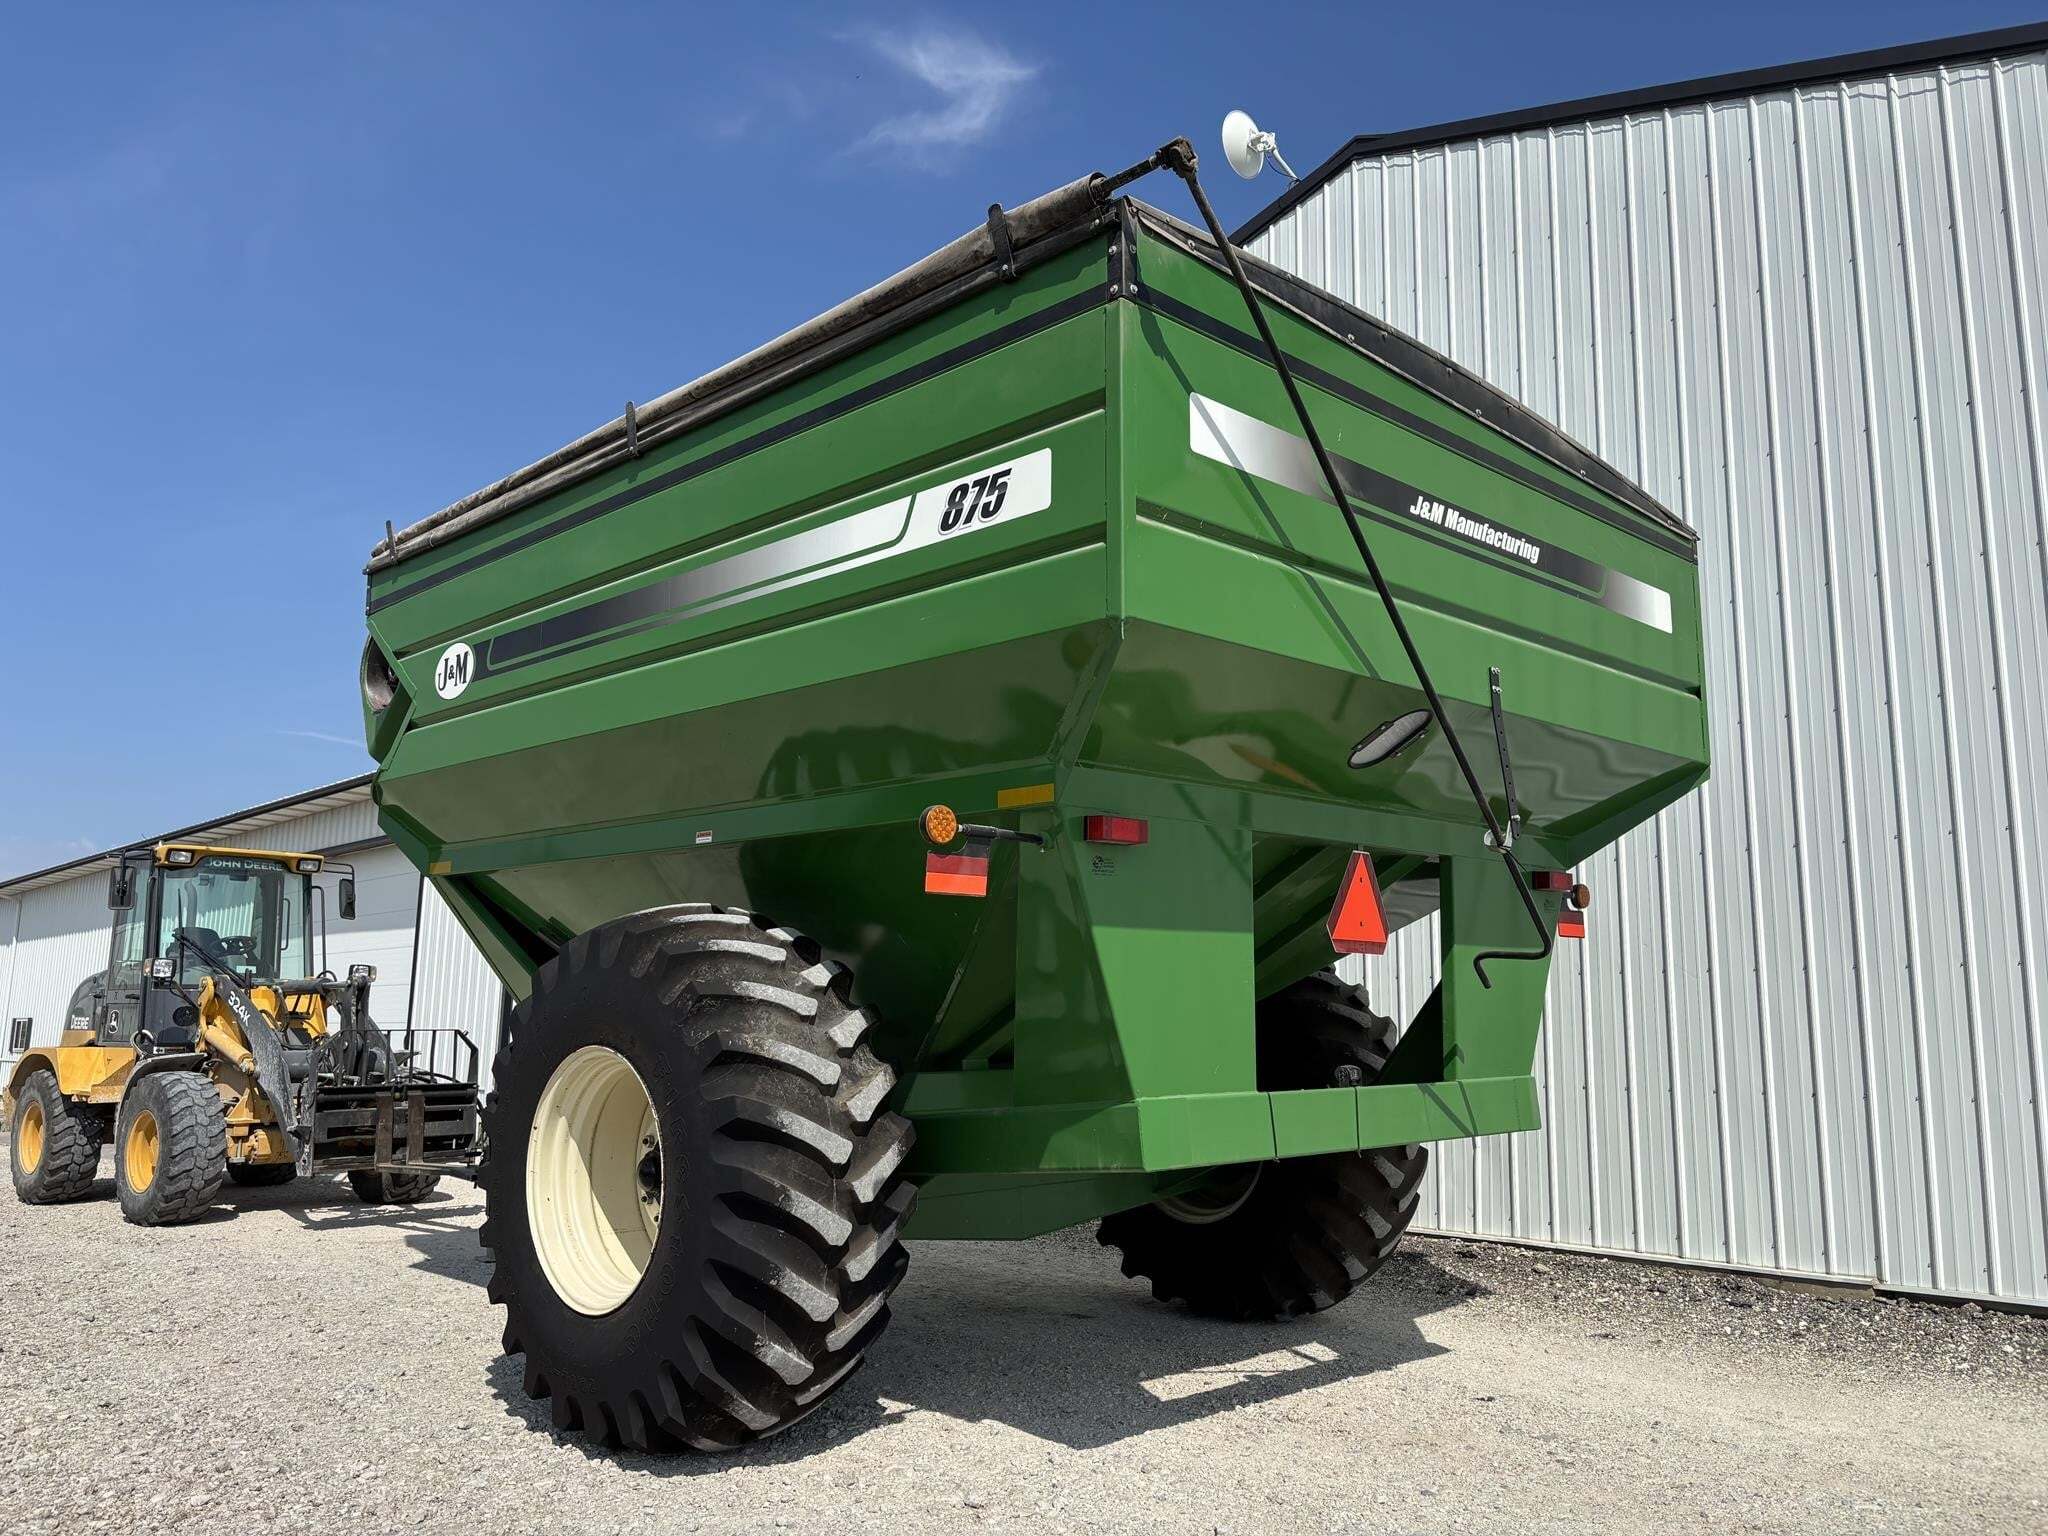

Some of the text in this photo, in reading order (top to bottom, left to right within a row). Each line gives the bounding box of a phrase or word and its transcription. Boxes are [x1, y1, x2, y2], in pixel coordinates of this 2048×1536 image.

[939, 467, 1012, 534] 875
[1409, 495, 1540, 565] J&M Manufacturing
[437, 650, 469, 692] J&M
[205, 856, 286, 872] JOHN DEERE
[70, 1014, 90, 1030] DEERE
[227, 989, 251, 1027] 324K
